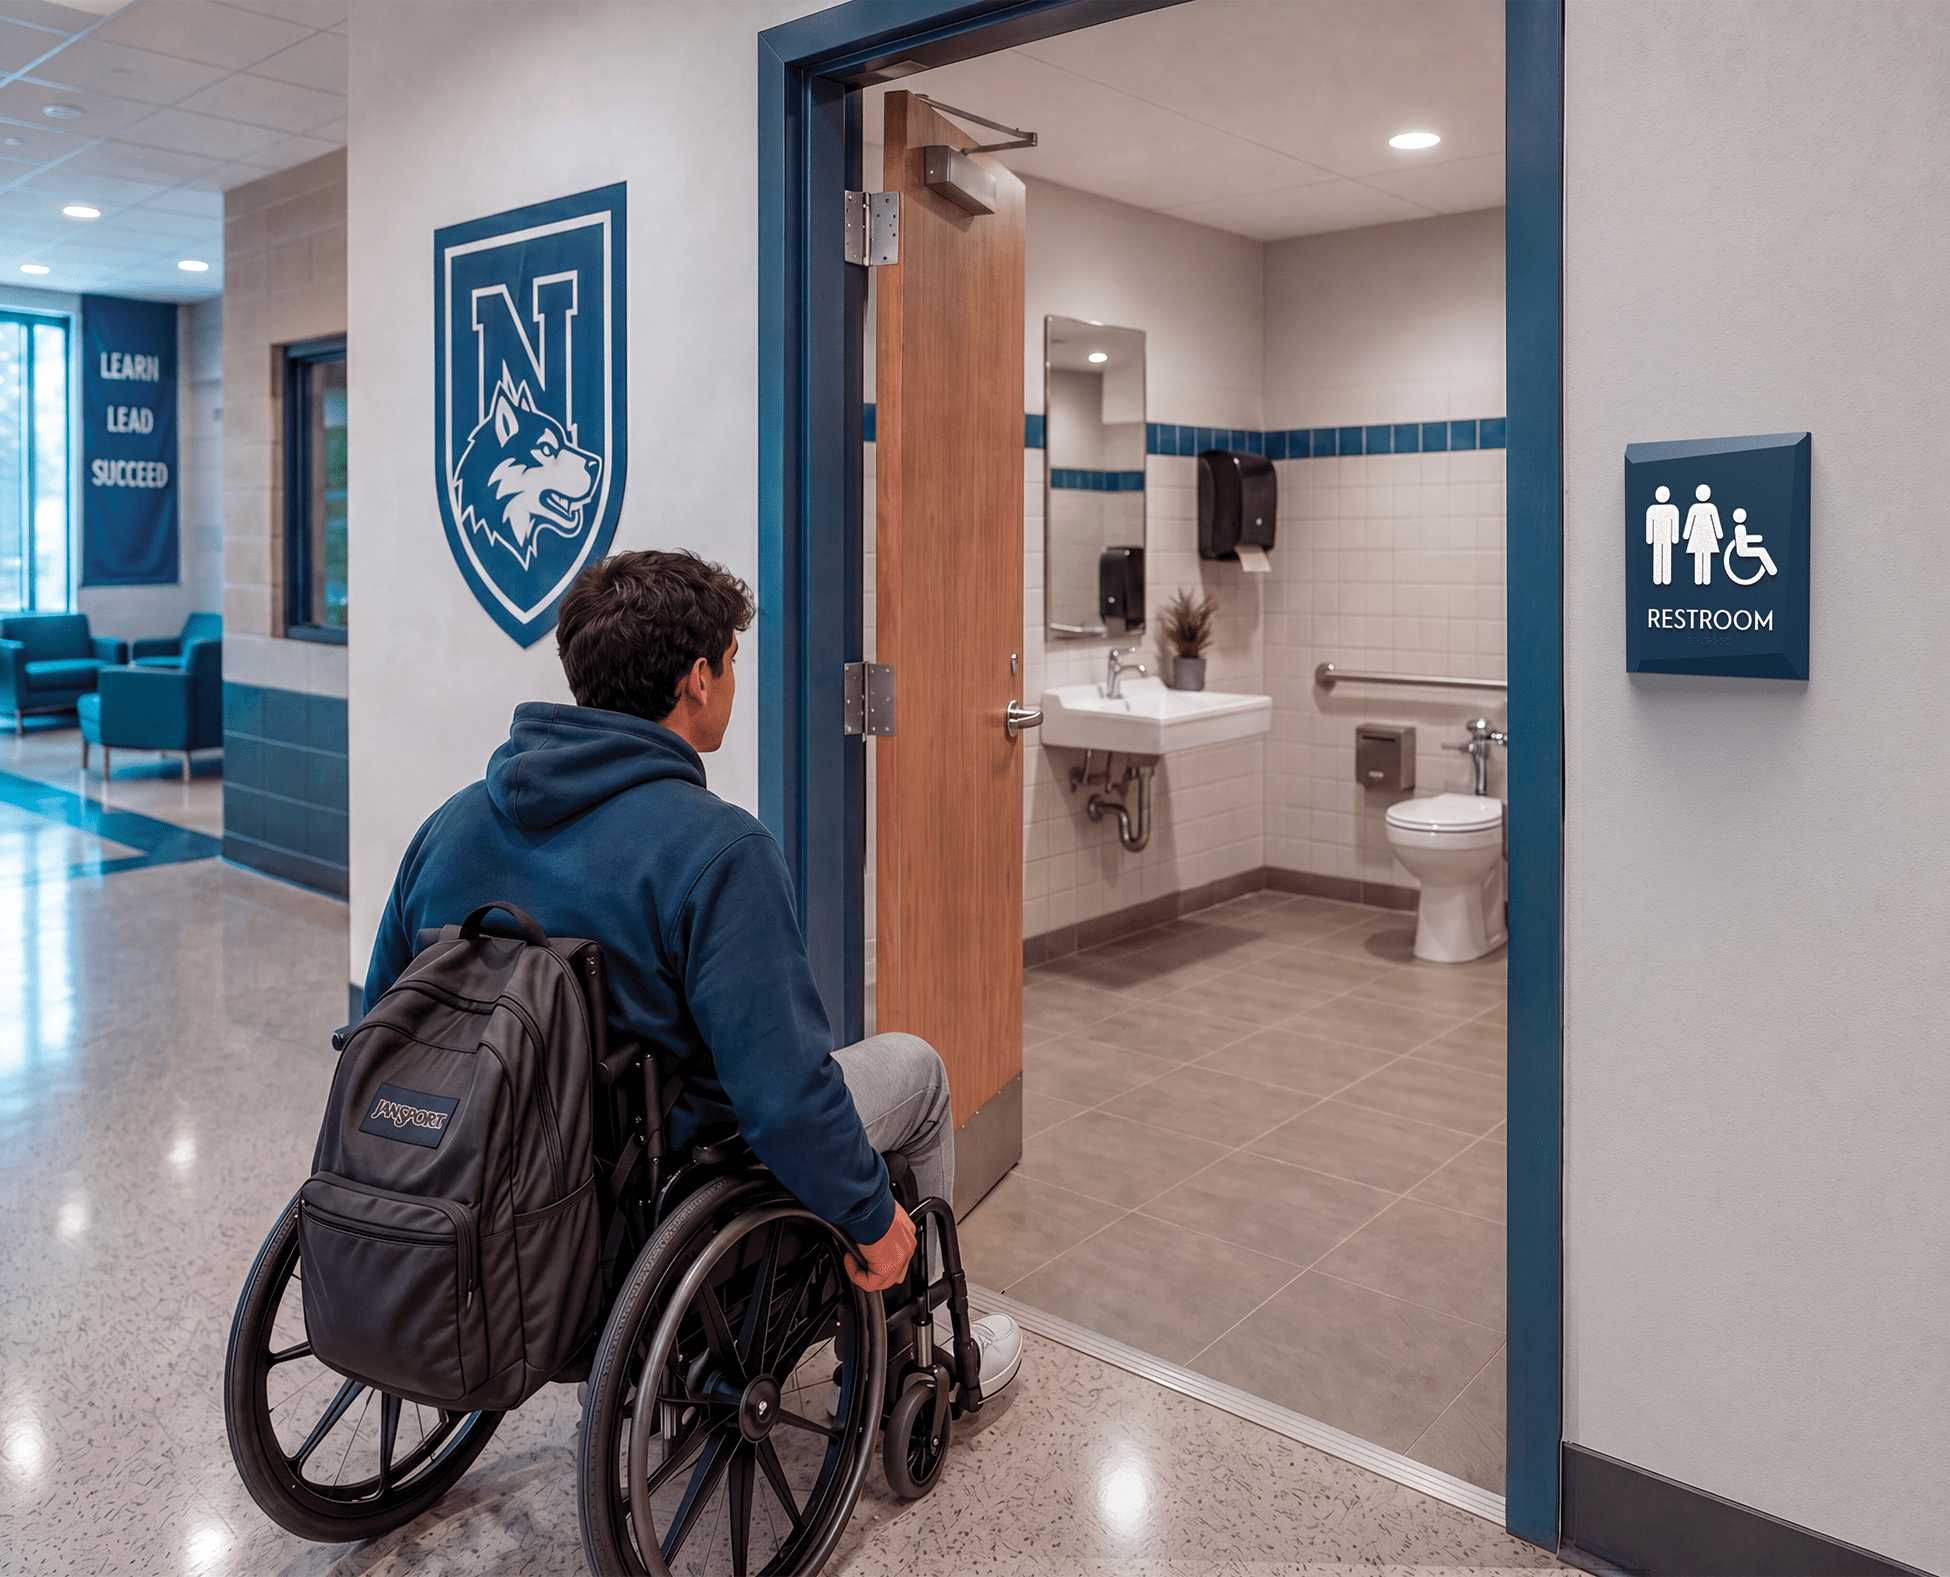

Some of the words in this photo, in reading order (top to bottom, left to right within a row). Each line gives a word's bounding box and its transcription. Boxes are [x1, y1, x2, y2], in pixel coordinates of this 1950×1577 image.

[100, 351, 160, 382] LEARN
[472, 269, 578, 448] N
[107, 404, 154, 434] LEAD
[91, 458, 169, 488] SUCCEED
[1648, 608, 1773, 631] RESTROOM
[370, 1098, 448, 1130] JANSPORT
